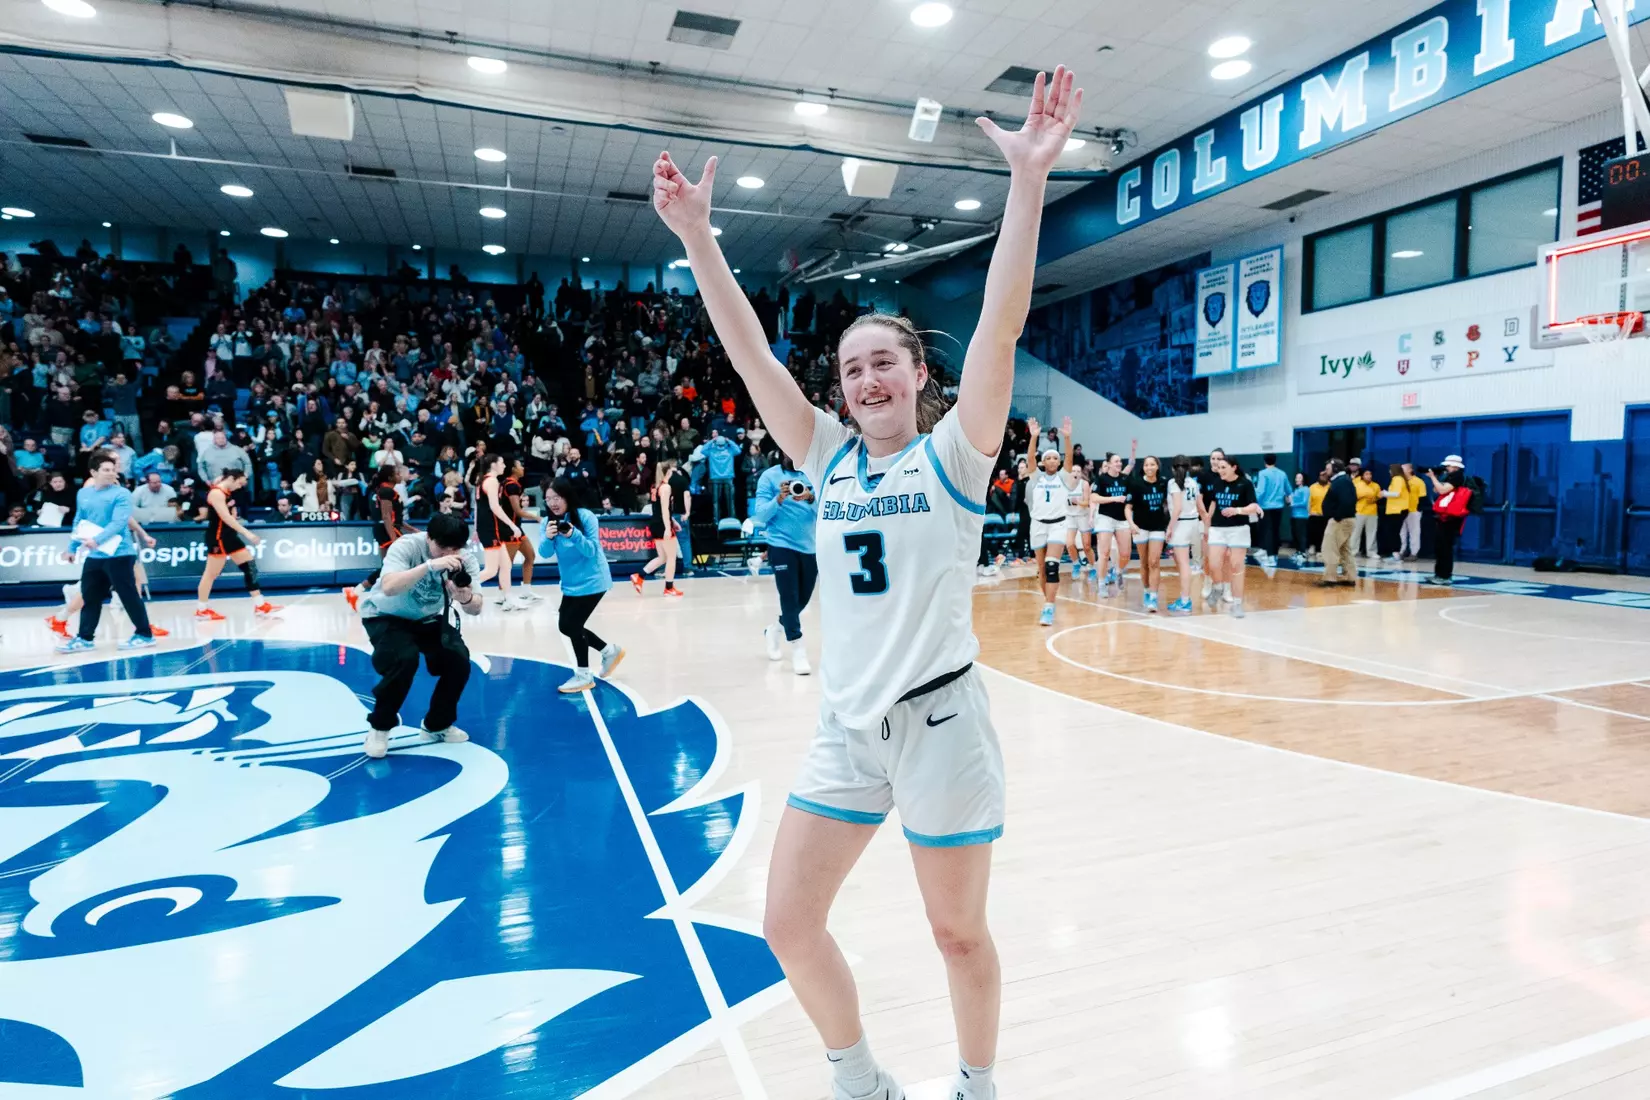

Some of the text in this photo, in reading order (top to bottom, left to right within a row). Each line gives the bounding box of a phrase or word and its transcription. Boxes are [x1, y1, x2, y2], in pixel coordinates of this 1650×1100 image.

[1319, 354, 1354, 379] Ivy
[1502, 345, 1519, 364] Y
[822, 492, 930, 521] COLUMBIA
[1045, 490, 1051, 503] 1
[0, 544, 88, 568] Offici
[274, 537, 380, 560] Columbi
[842, 529, 890, 596] 3
